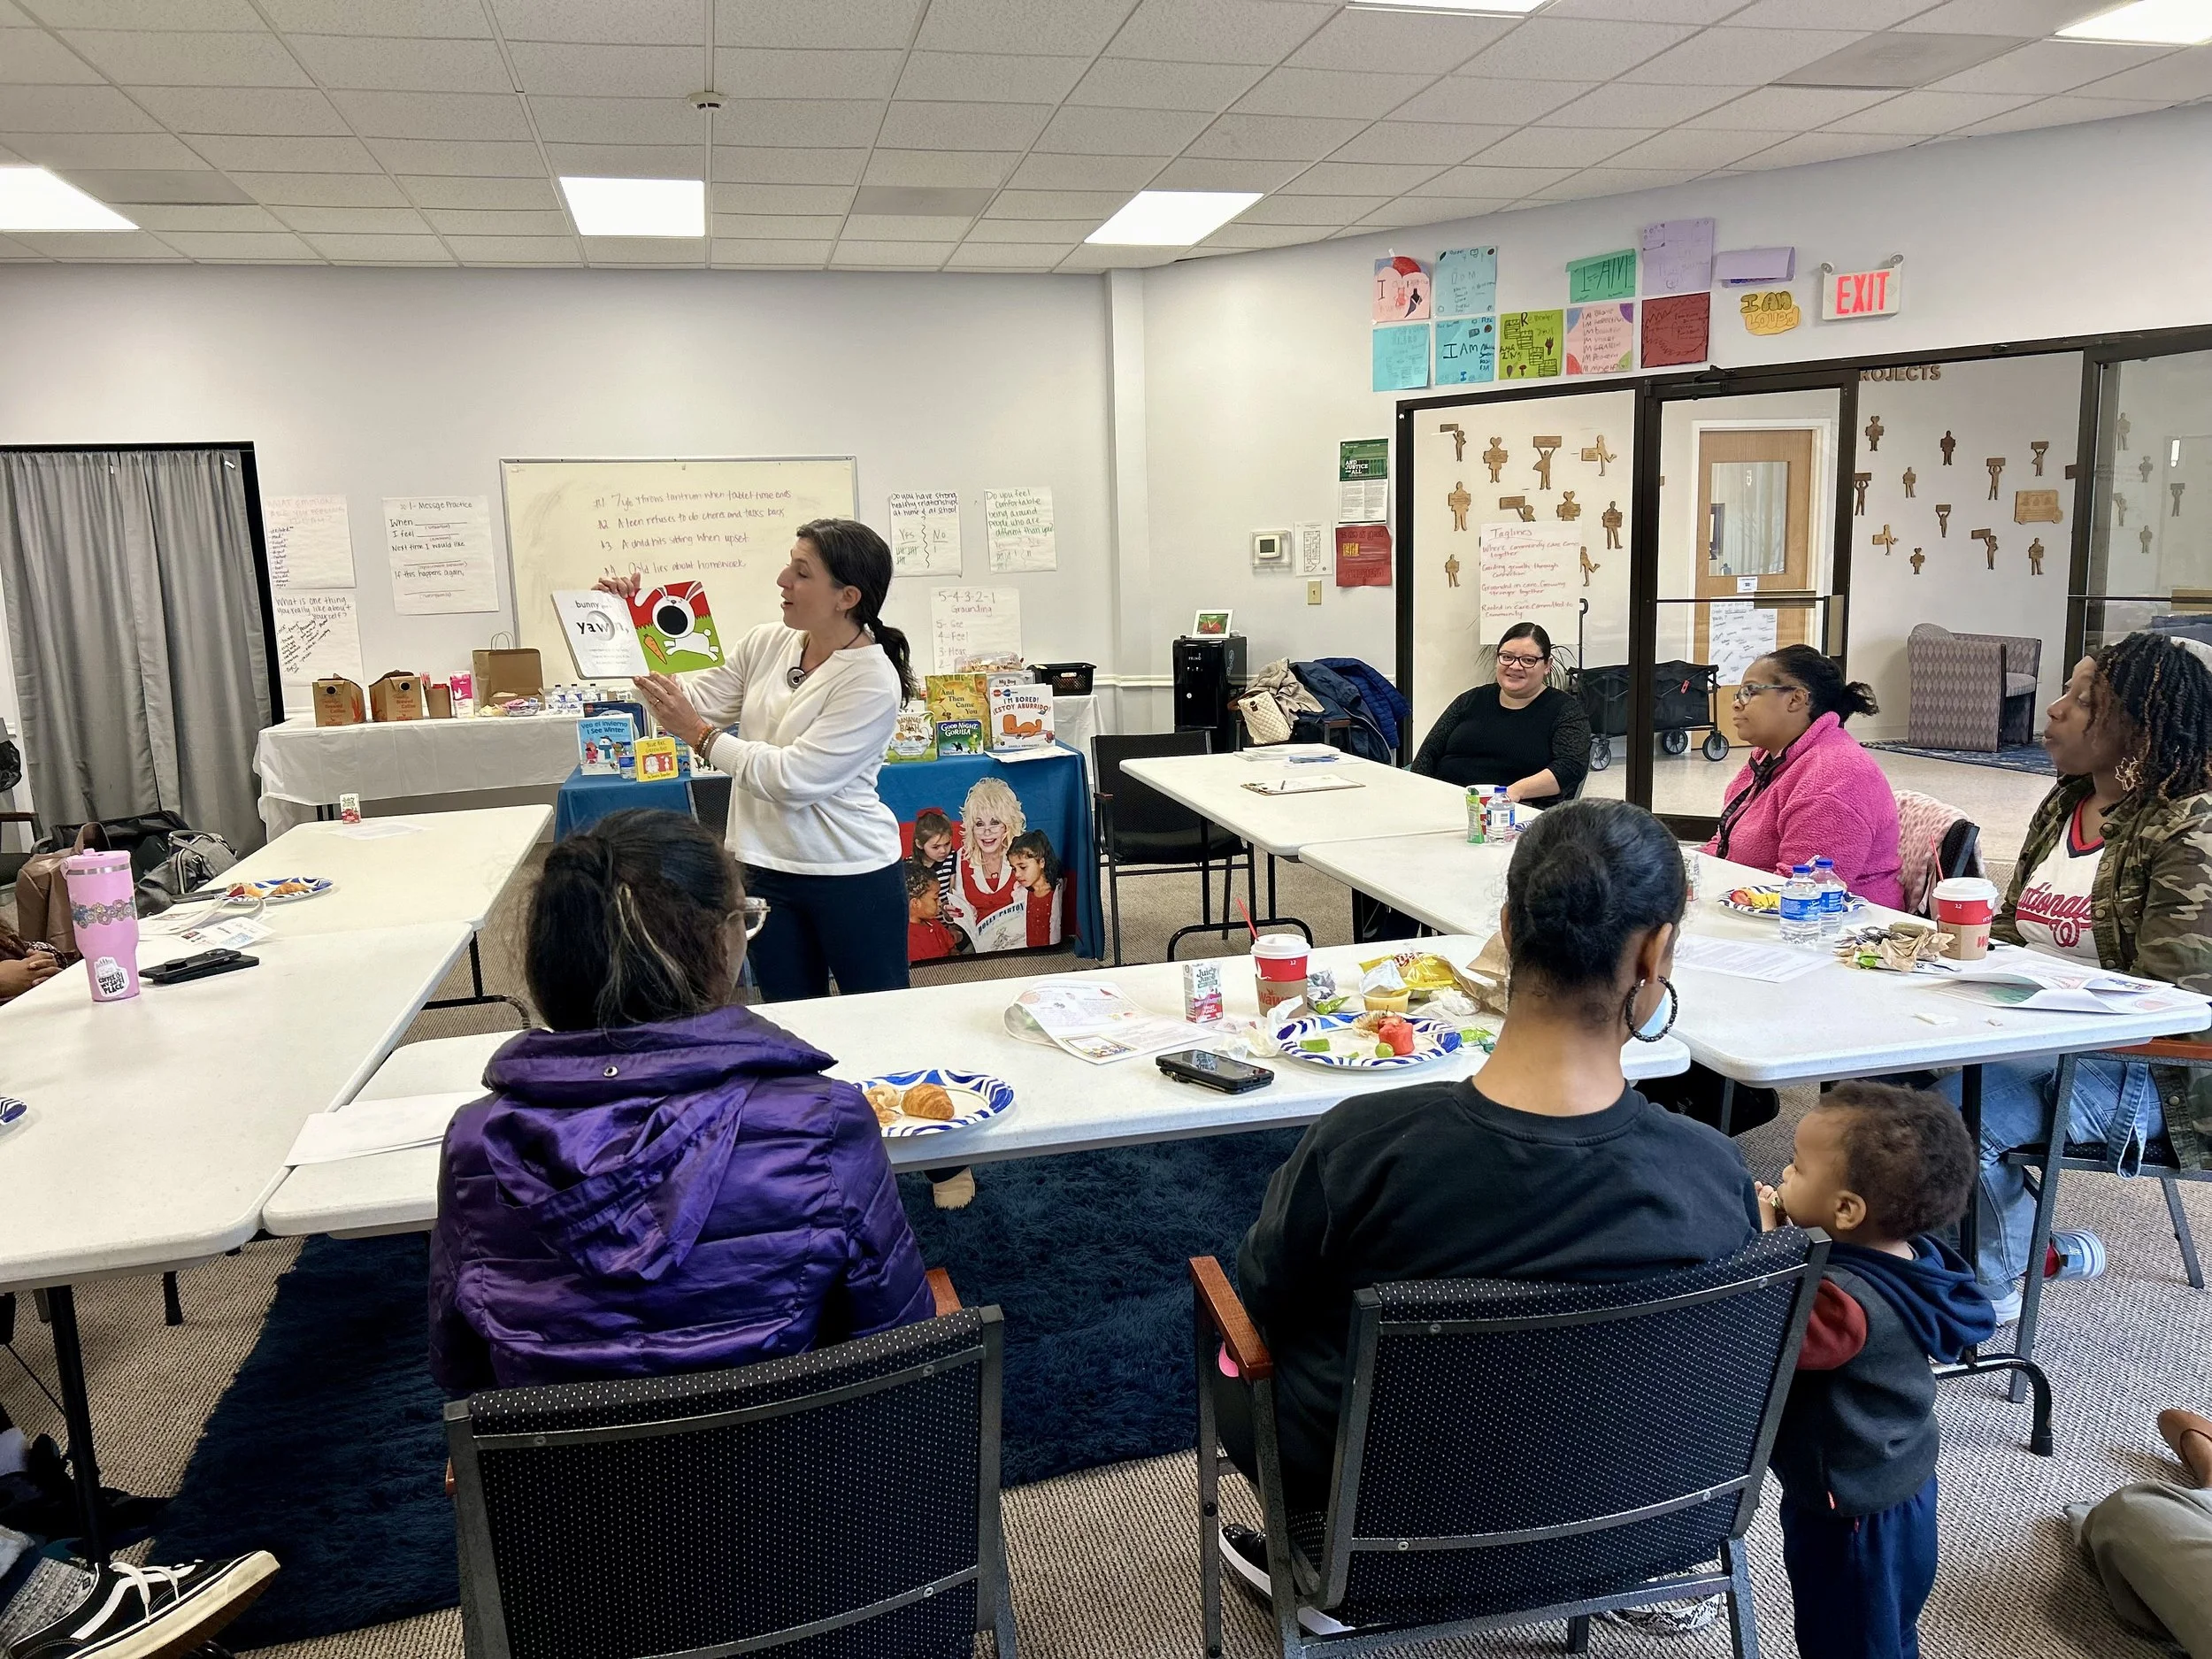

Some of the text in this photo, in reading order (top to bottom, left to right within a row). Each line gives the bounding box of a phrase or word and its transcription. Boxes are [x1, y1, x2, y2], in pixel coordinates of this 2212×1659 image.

[1597, 255, 1628, 290] AM
[1835, 271, 1891, 315] EXIT
[1740, 290, 1793, 313] I AM
[1443, 342, 1458, 359] I
[1460, 342, 1479, 357] AM
[611, 493, 621, 507] 7
[667, 492, 701, 501] tantrum
[704, 490, 725, 499] when
[901, 493, 914, 503] you
[986, 491, 998, 500] Do
[1015, 488, 1031, 497] feel
[446, 500, 472, 509] Practice
[995, 497, 1041, 509] comfortable
[646, 514, 675, 526] refuses
[727, 510, 742, 518] and
[767, 507, 785, 518] back
[1010, 507, 1038, 518] around
[1490, 527, 1532, 539] Taglines
[622, 539, 629, 549] A
[697, 532, 720, 541] when
[725, 532, 749, 547] upset
[419, 568, 442, 579] happens
[275, 596, 296, 606] What
[324, 596, 347, 606] thing
[575, 600, 599, 610] bunny
[277, 608, 290, 617] you
[290, 607, 311, 618] really
[951, 605, 992, 617] Grounding
[951, 632, 968, 641] Feel
[1017, 703, 1051, 712] ABURRIDO!
[944, 728, 972, 737] GORILLA
[978, 902, 1025, 936] DOLLY PARTON
[1196, 966, 1217, 978] Juicy
[98, 974, 116, 983] COFFEE
[104, 983, 124, 995] PLACE
[1259, 991, 1294, 1007] Waw
